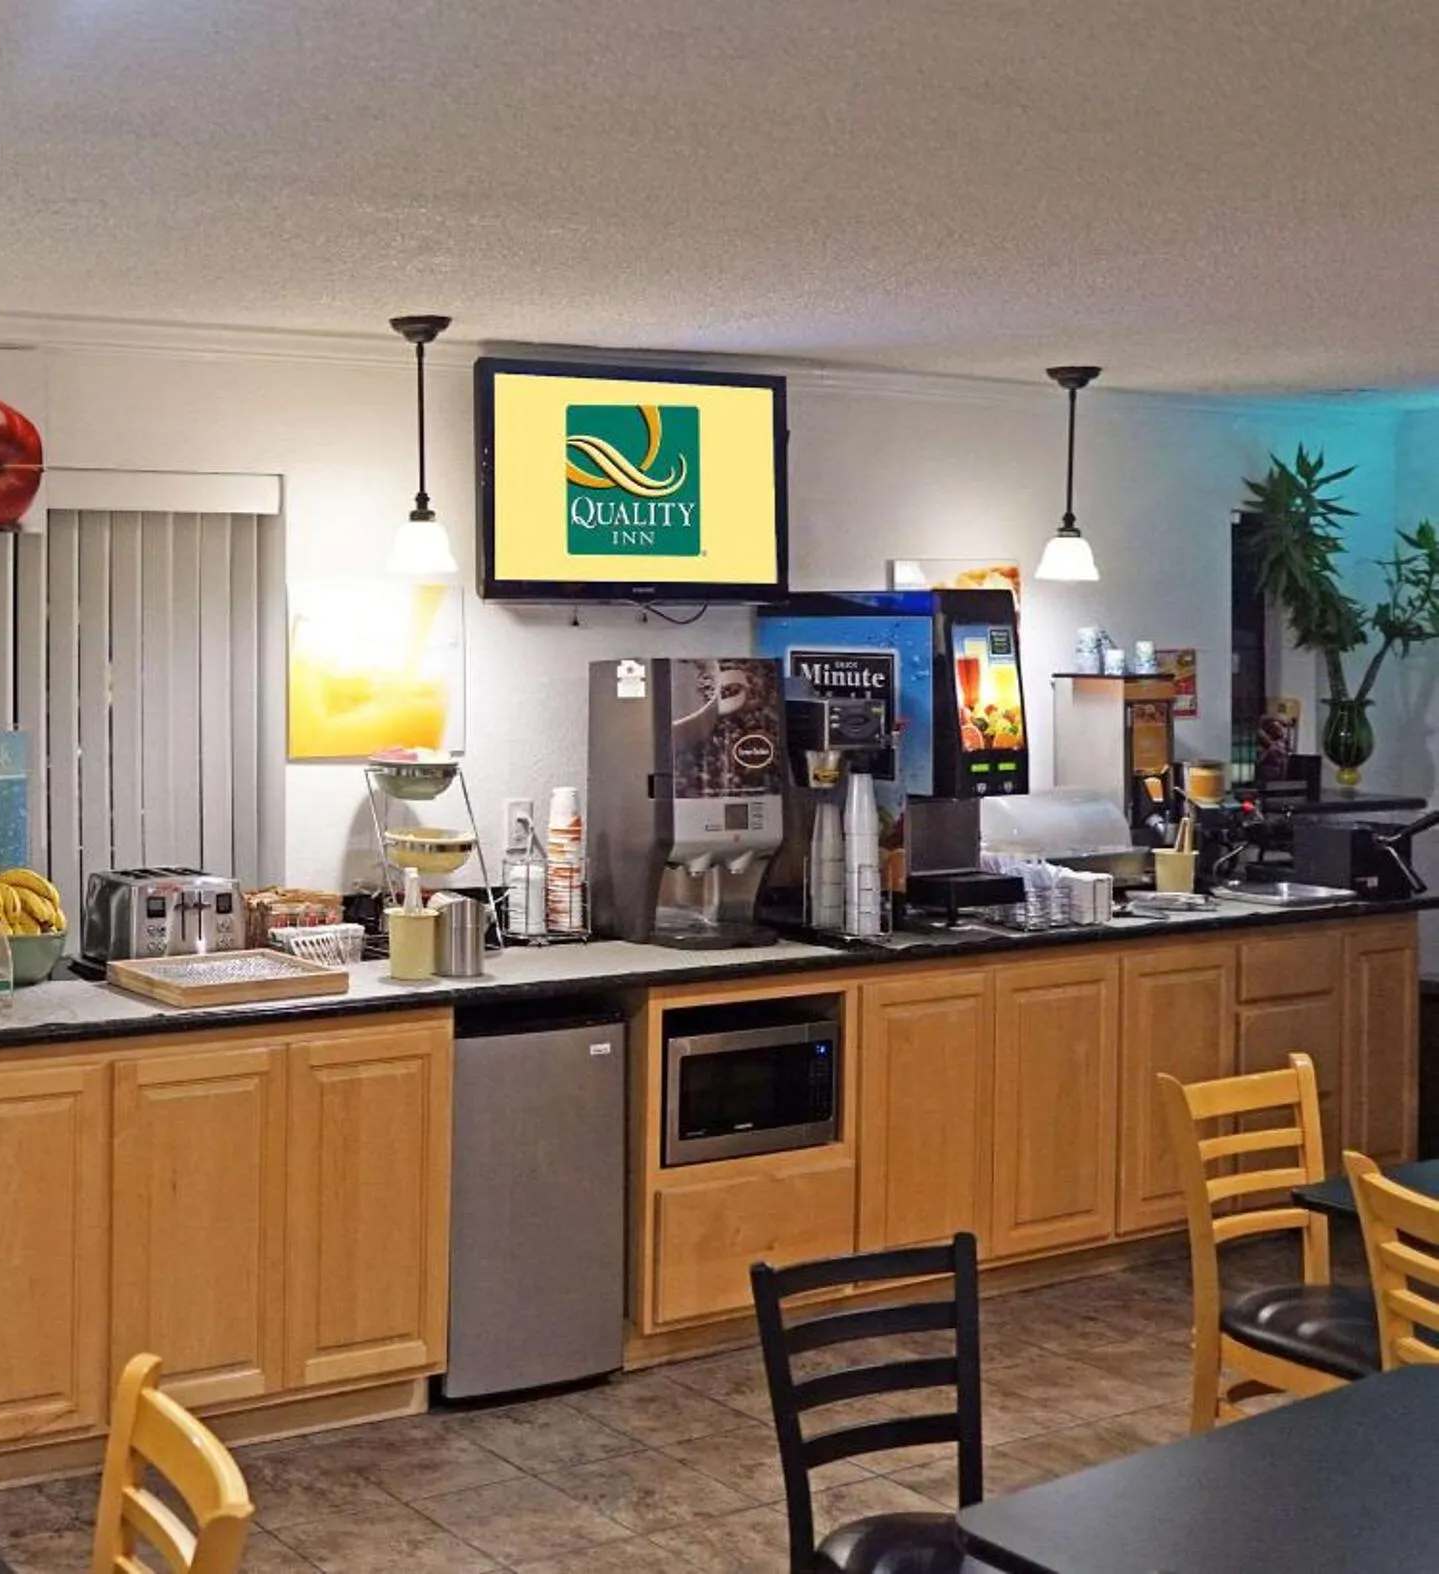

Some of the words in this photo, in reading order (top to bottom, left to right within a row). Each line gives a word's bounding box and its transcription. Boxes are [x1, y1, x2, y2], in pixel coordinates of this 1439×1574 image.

[571, 496, 695, 529] QUALITY
[613, 531, 655, 545] INN
[800, 663, 886, 688] Minute
